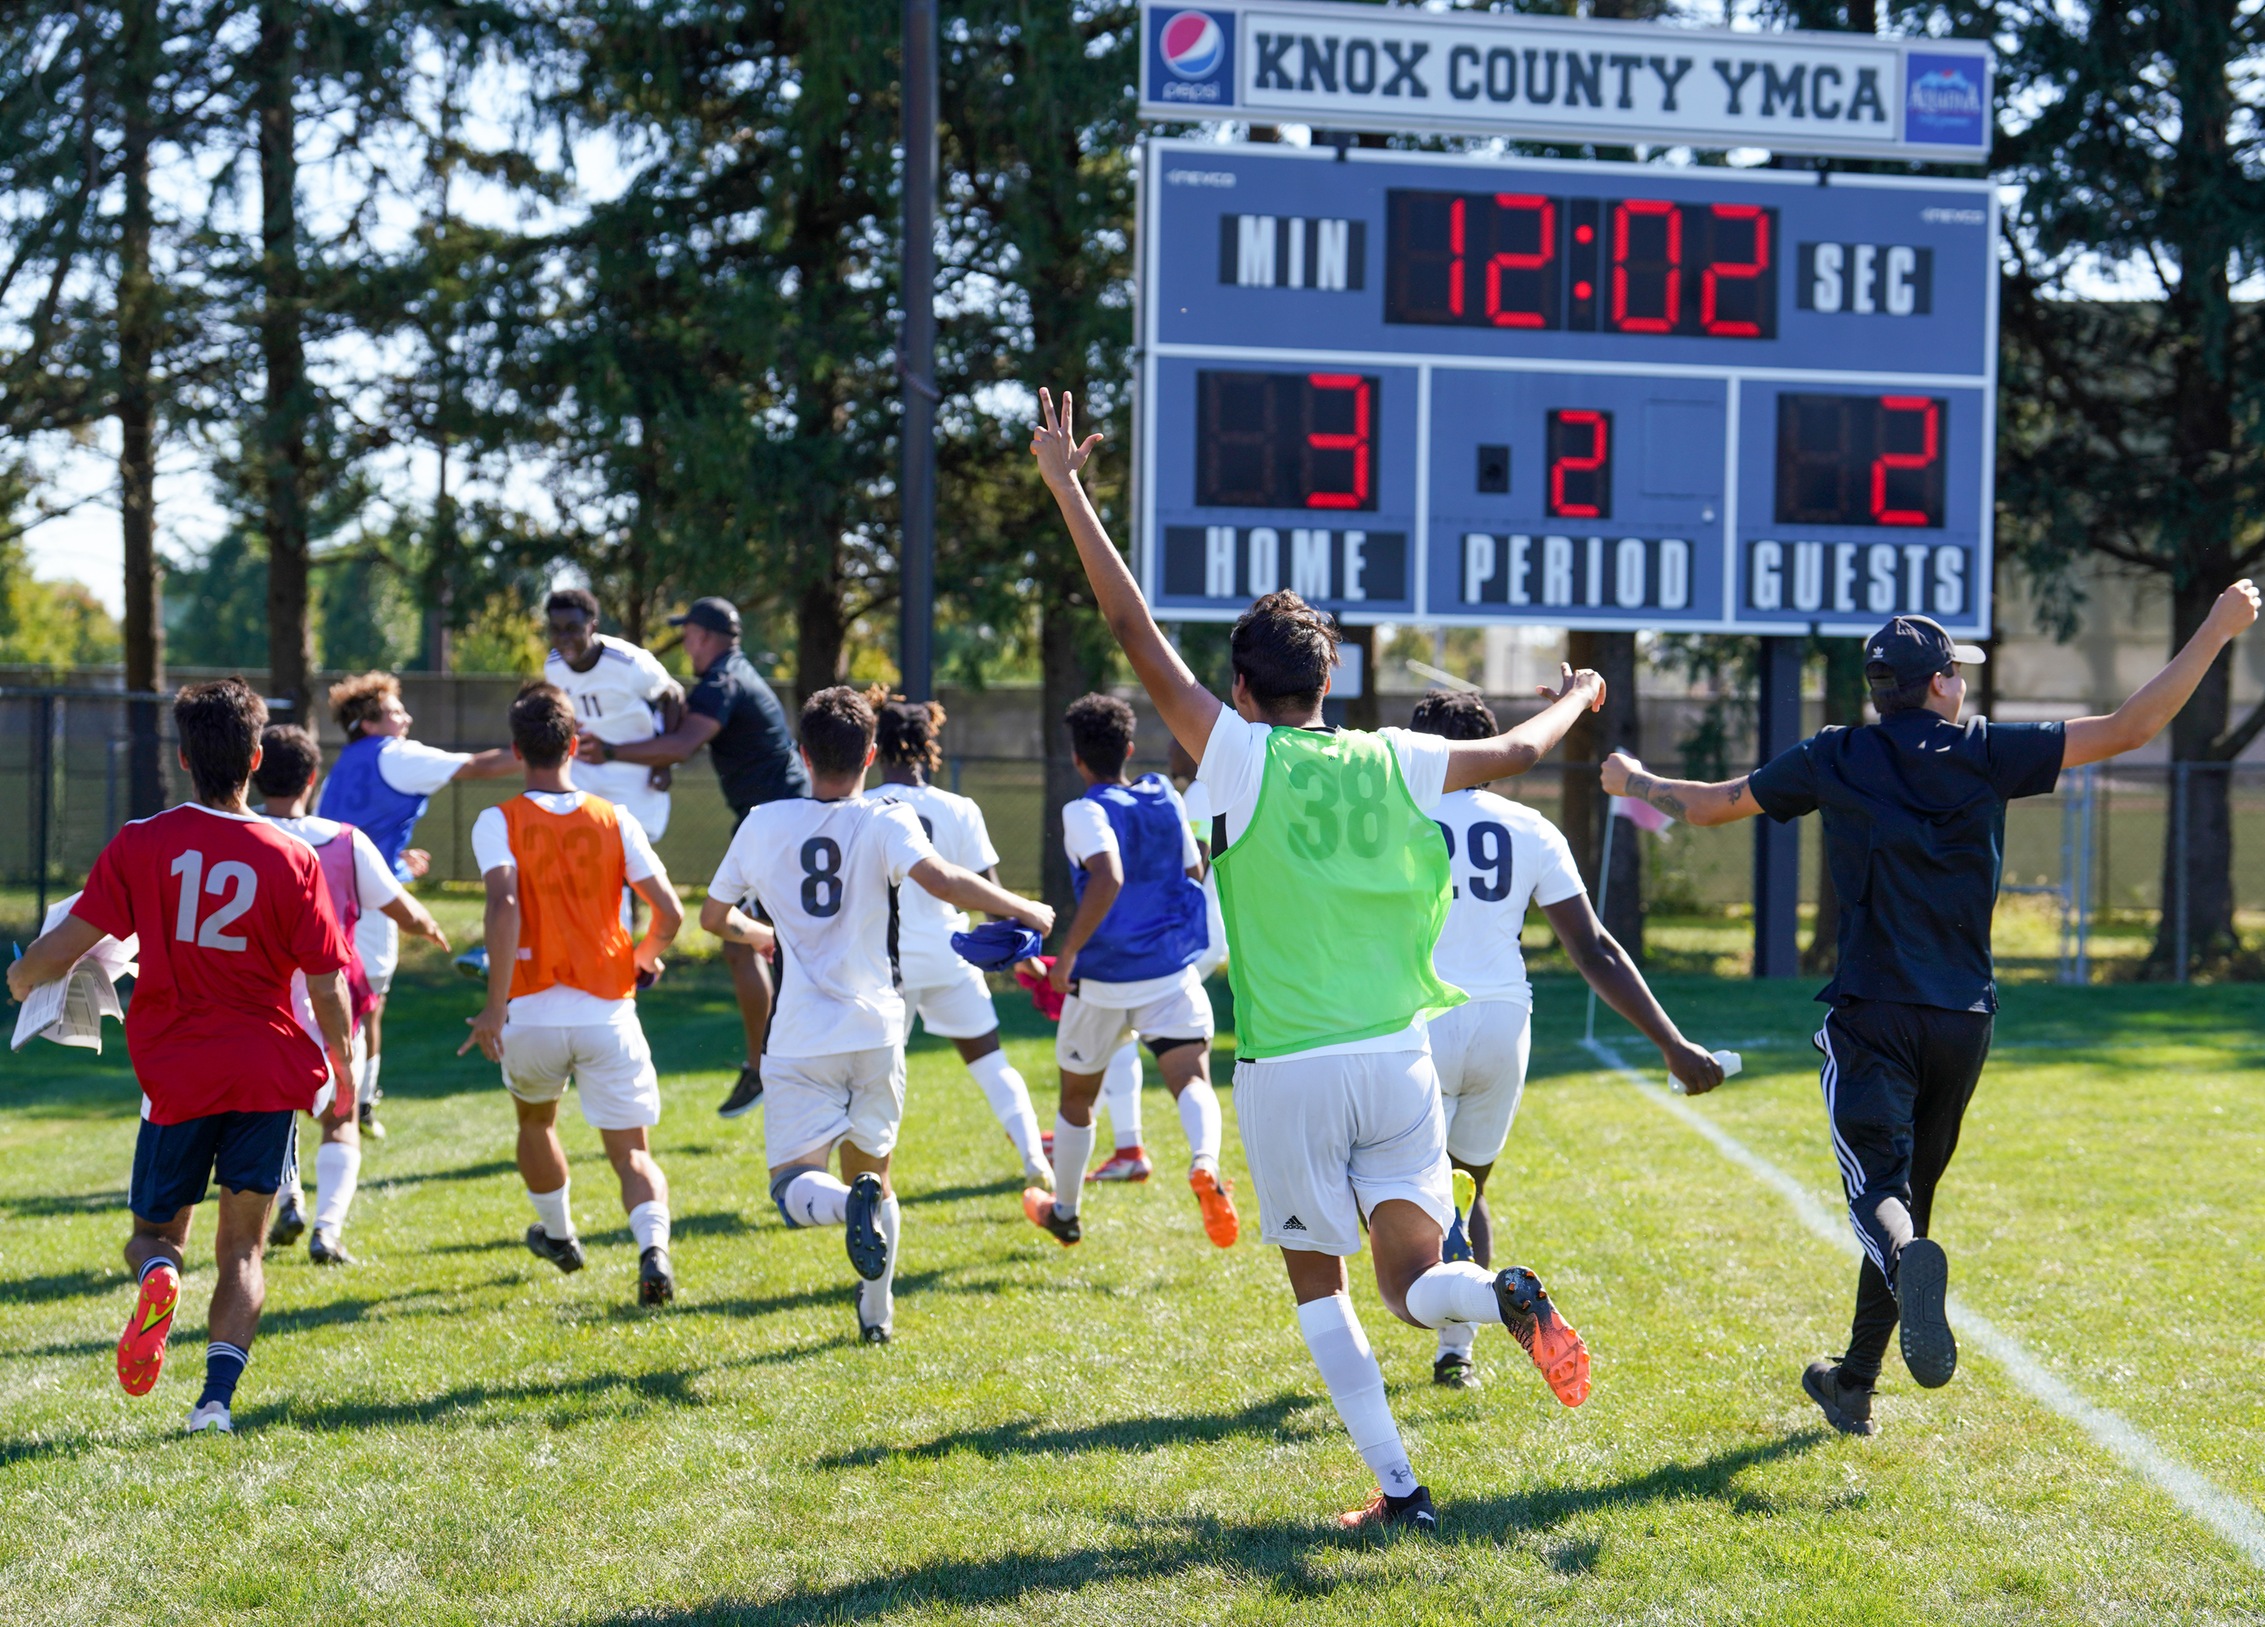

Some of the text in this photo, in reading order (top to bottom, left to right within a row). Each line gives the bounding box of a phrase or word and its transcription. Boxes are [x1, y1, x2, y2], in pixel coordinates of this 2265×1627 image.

[1163, 82, 1220, 101] pepsi
[1256, 32, 1886, 122] KNOX COUNTY YMCA
[1237, 214, 1349, 292] MIN
[1449, 193, 1770, 337] 12:02
[1813, 242, 1916, 316] SEC
[1306, 373, 1370, 509] 3
[1551, 409, 1607, 518] 2
[1870, 395, 1938, 526] 2
[1205, 525, 1367, 601] HOME
[1465, 533, 1689, 610] PERIOD
[1753, 540, 1964, 616] GUESTS
[581, 694, 602, 717] 11
[1287, 757, 1389, 861] 38
[171, 849, 258, 952] 12
[522, 823, 603, 900] 23
[801, 837, 843, 917] 8
